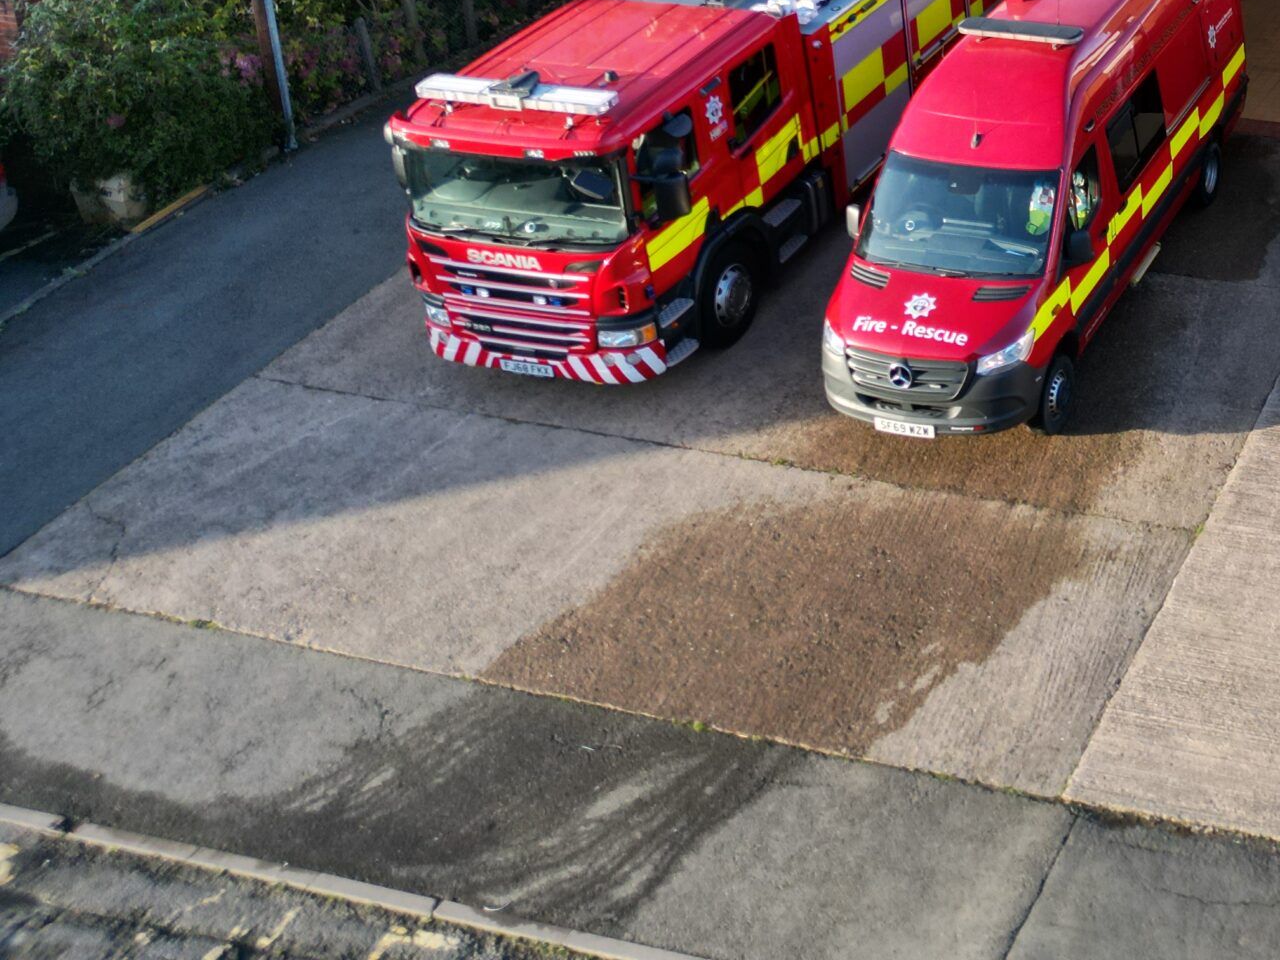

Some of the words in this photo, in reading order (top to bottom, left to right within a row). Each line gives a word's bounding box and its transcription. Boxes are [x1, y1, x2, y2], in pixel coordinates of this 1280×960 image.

[466, 248, 543, 271] SCANIA
[852, 316, 888, 333] Fire
[901, 320, 969, 346] Rescue
